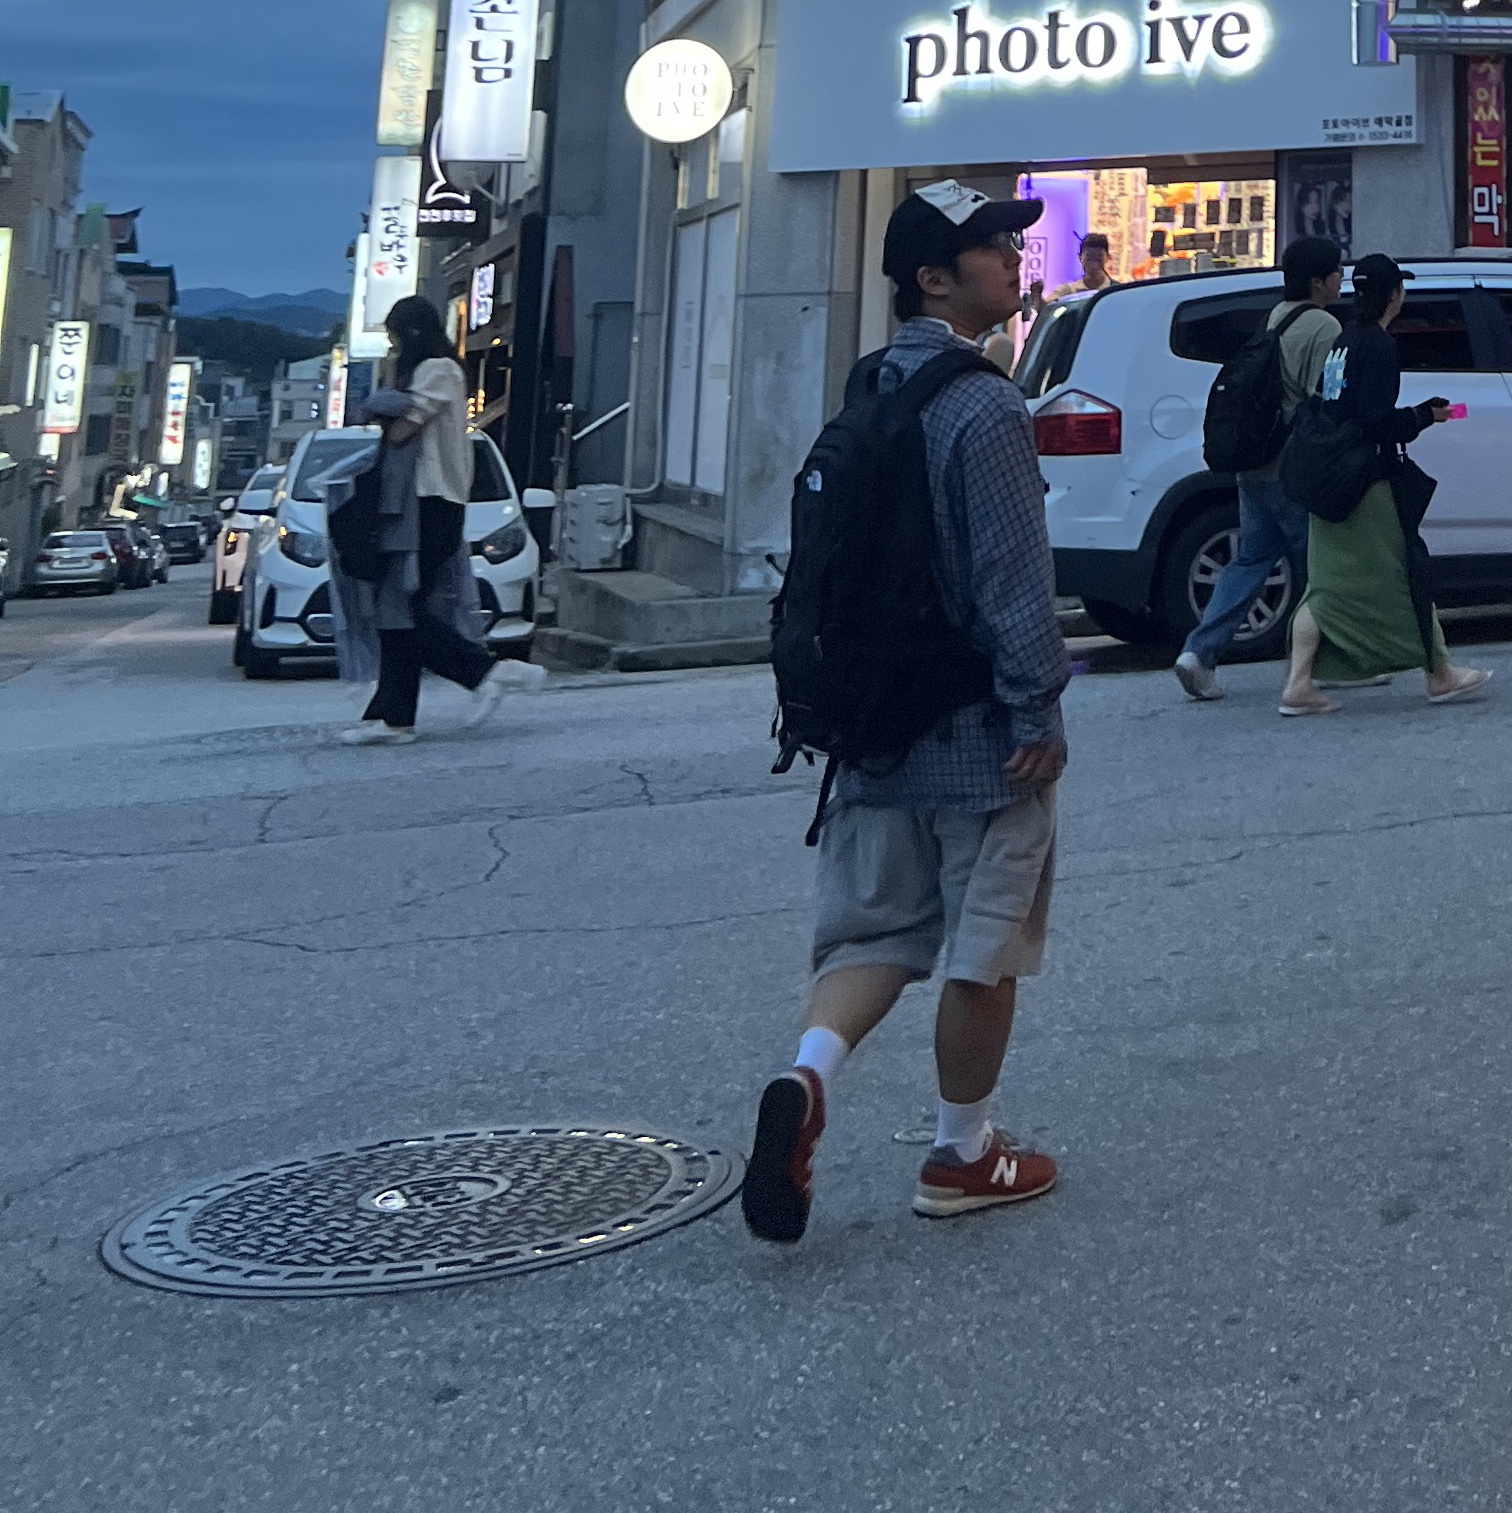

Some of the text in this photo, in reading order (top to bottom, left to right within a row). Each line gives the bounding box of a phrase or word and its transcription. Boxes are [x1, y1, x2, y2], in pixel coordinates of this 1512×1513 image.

[903, 0, 1252, 104] photo ive
[989, 1155, 1018, 1187] N
